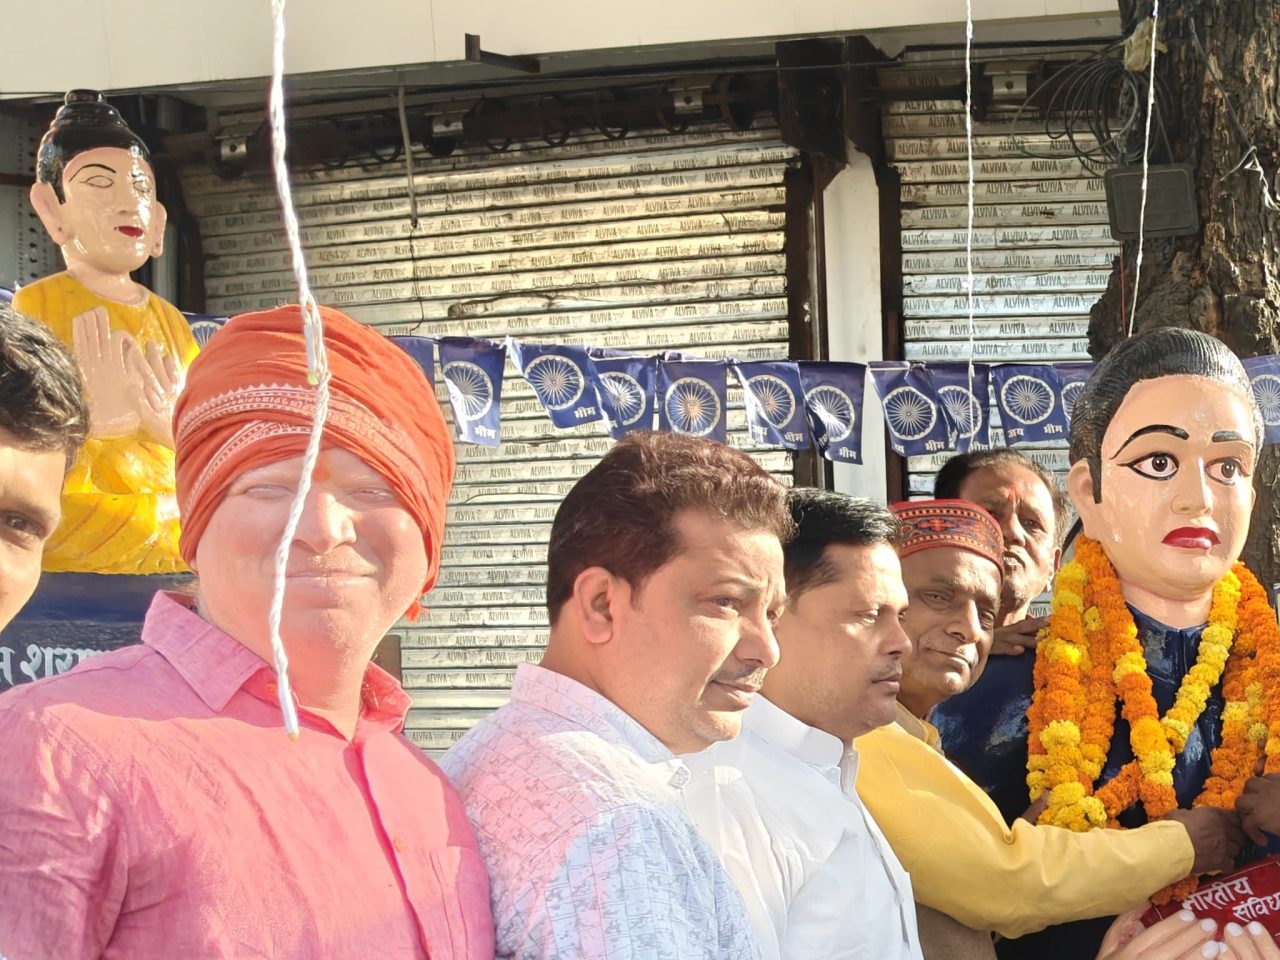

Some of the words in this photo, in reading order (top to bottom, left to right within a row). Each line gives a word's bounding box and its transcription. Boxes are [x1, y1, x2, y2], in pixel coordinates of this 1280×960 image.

[930, 165, 957, 176] ALVIVA
[980, 162, 1007, 174] ALVIVA
[1030, 161, 1057, 172] ALVIVA
[688, 197, 710, 209] ALVIVA
[1072, 205, 1099, 217] ALVIVA
[637, 224, 659, 235] ALVIVA
[935, 278, 962, 290] ALVIVA
[922, 346, 949, 356] ALVIVA
[574, 406, 596, 419] भीम
[474, 425, 497, 439] भीम
[1007, 427, 1024, 438] जय
[1043, 423, 1062, 434] भीम
[784, 431, 803, 443] भीम
[924, 440, 945, 452] भीम
[838, 446, 857, 460] भीम
